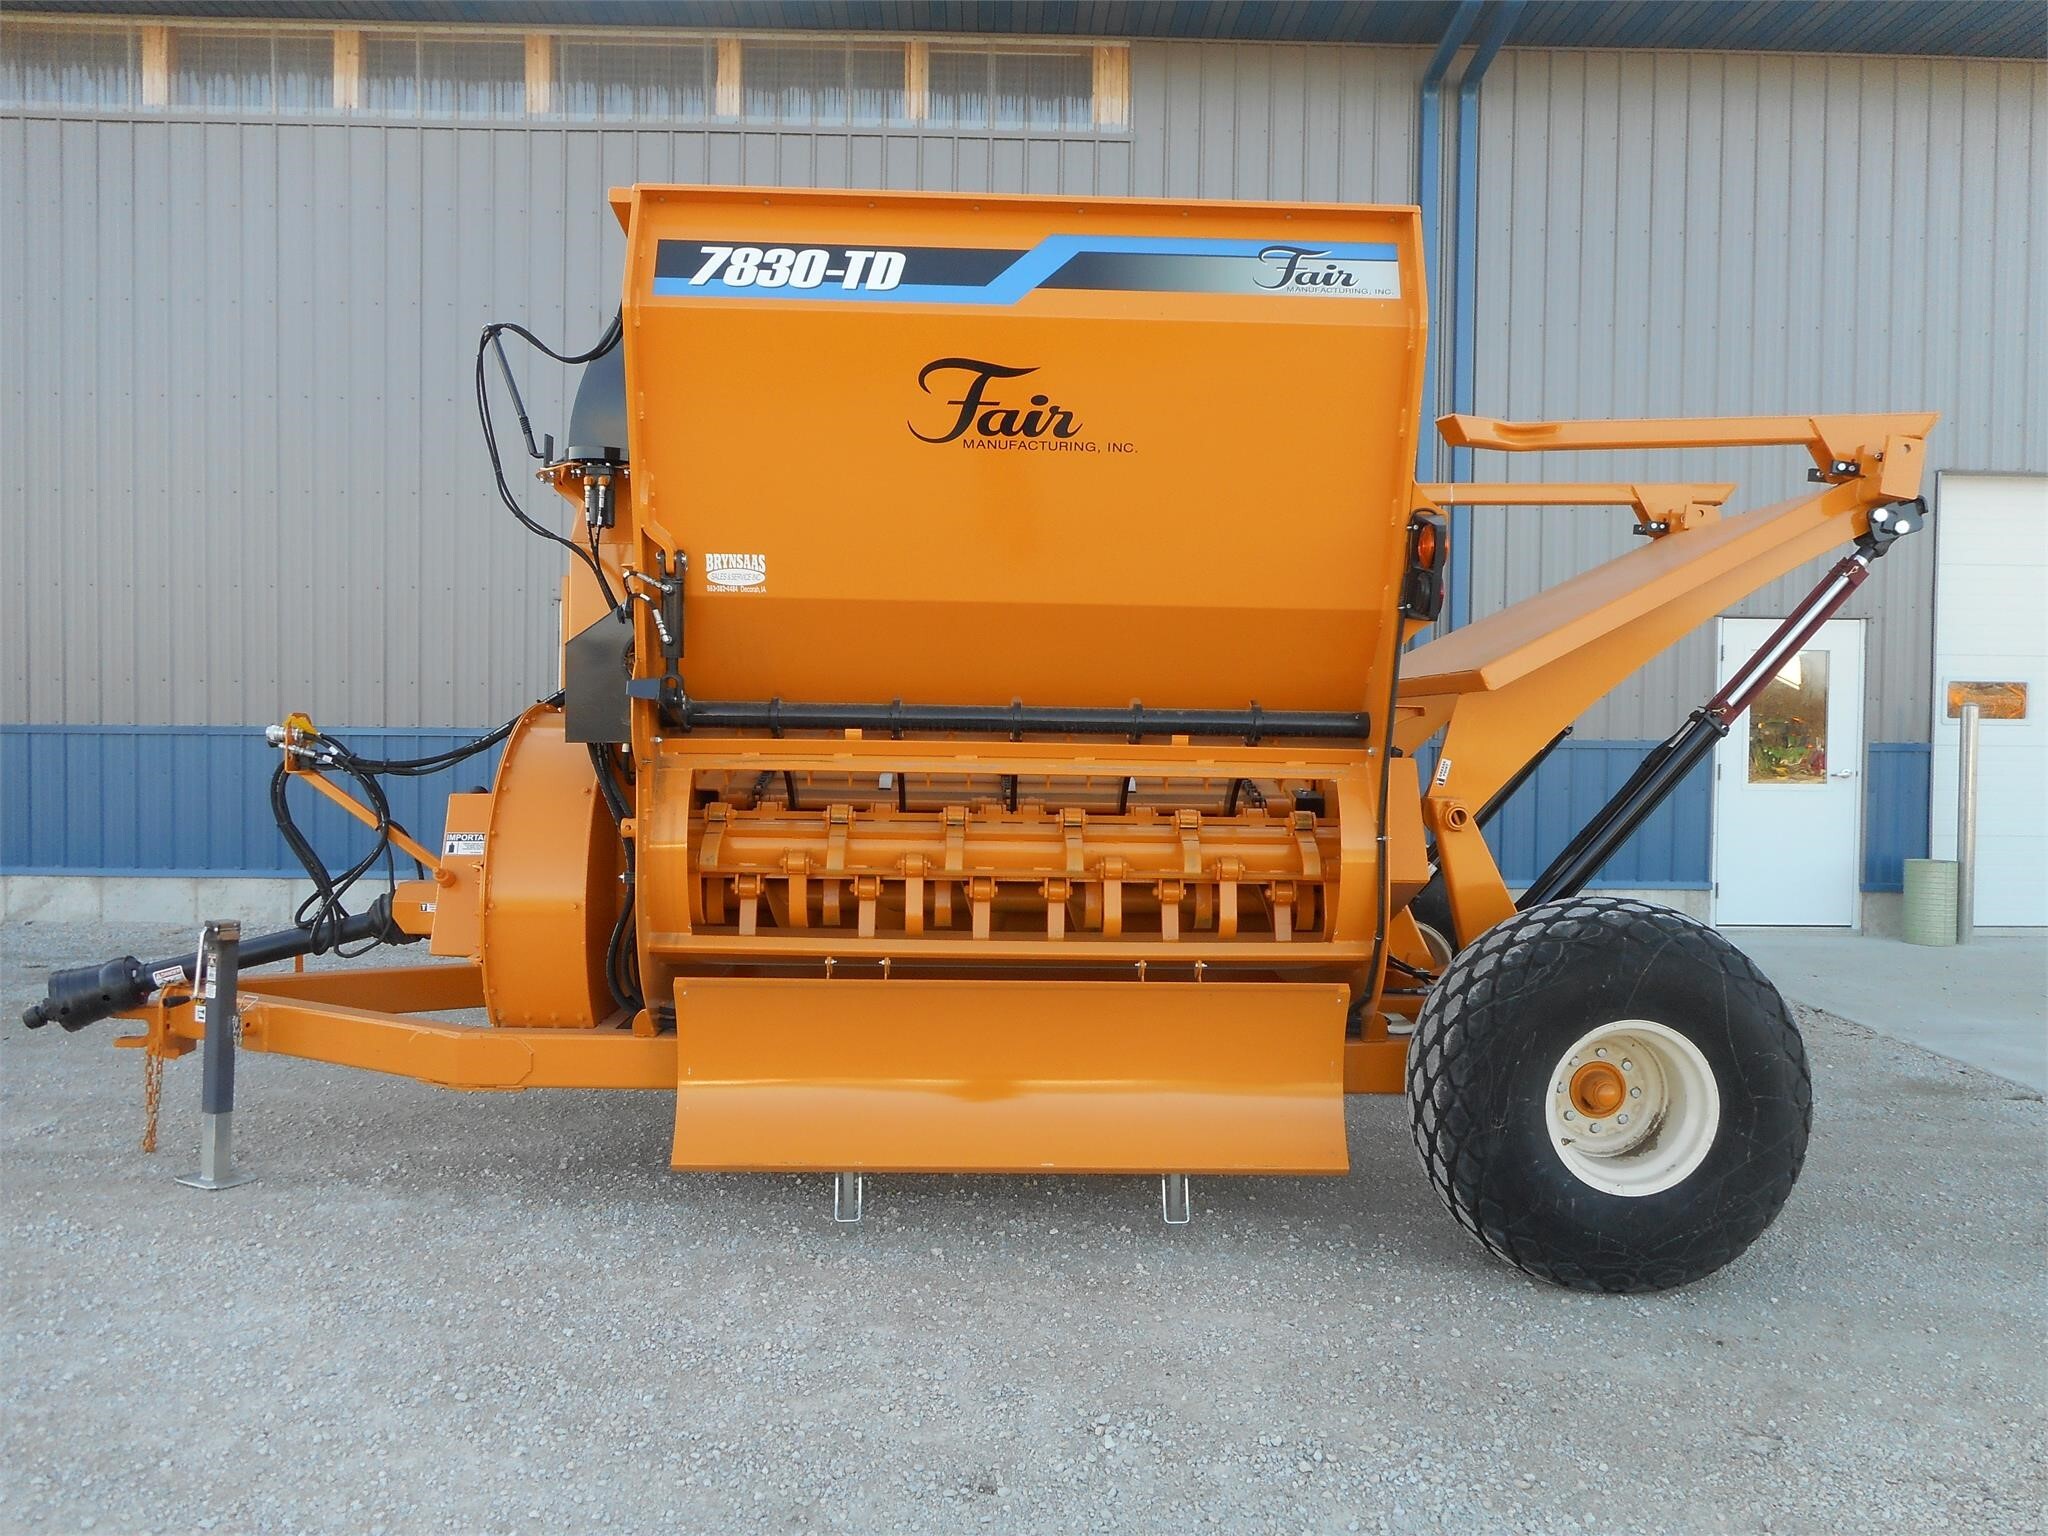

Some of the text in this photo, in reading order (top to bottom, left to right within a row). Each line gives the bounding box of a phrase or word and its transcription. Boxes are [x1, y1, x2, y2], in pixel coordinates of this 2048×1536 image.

[688, 246, 907, 291] 7830-TD
[1252, 245, 1360, 289] Fair
[1286, 286, 1395, 296] MANUFACTURING, INC.
[907, 357, 1084, 443] Fair
[963, 438, 1139, 454] MANUFACTURING, INC.
[705, 553, 766, 573] BRYNSAAS
